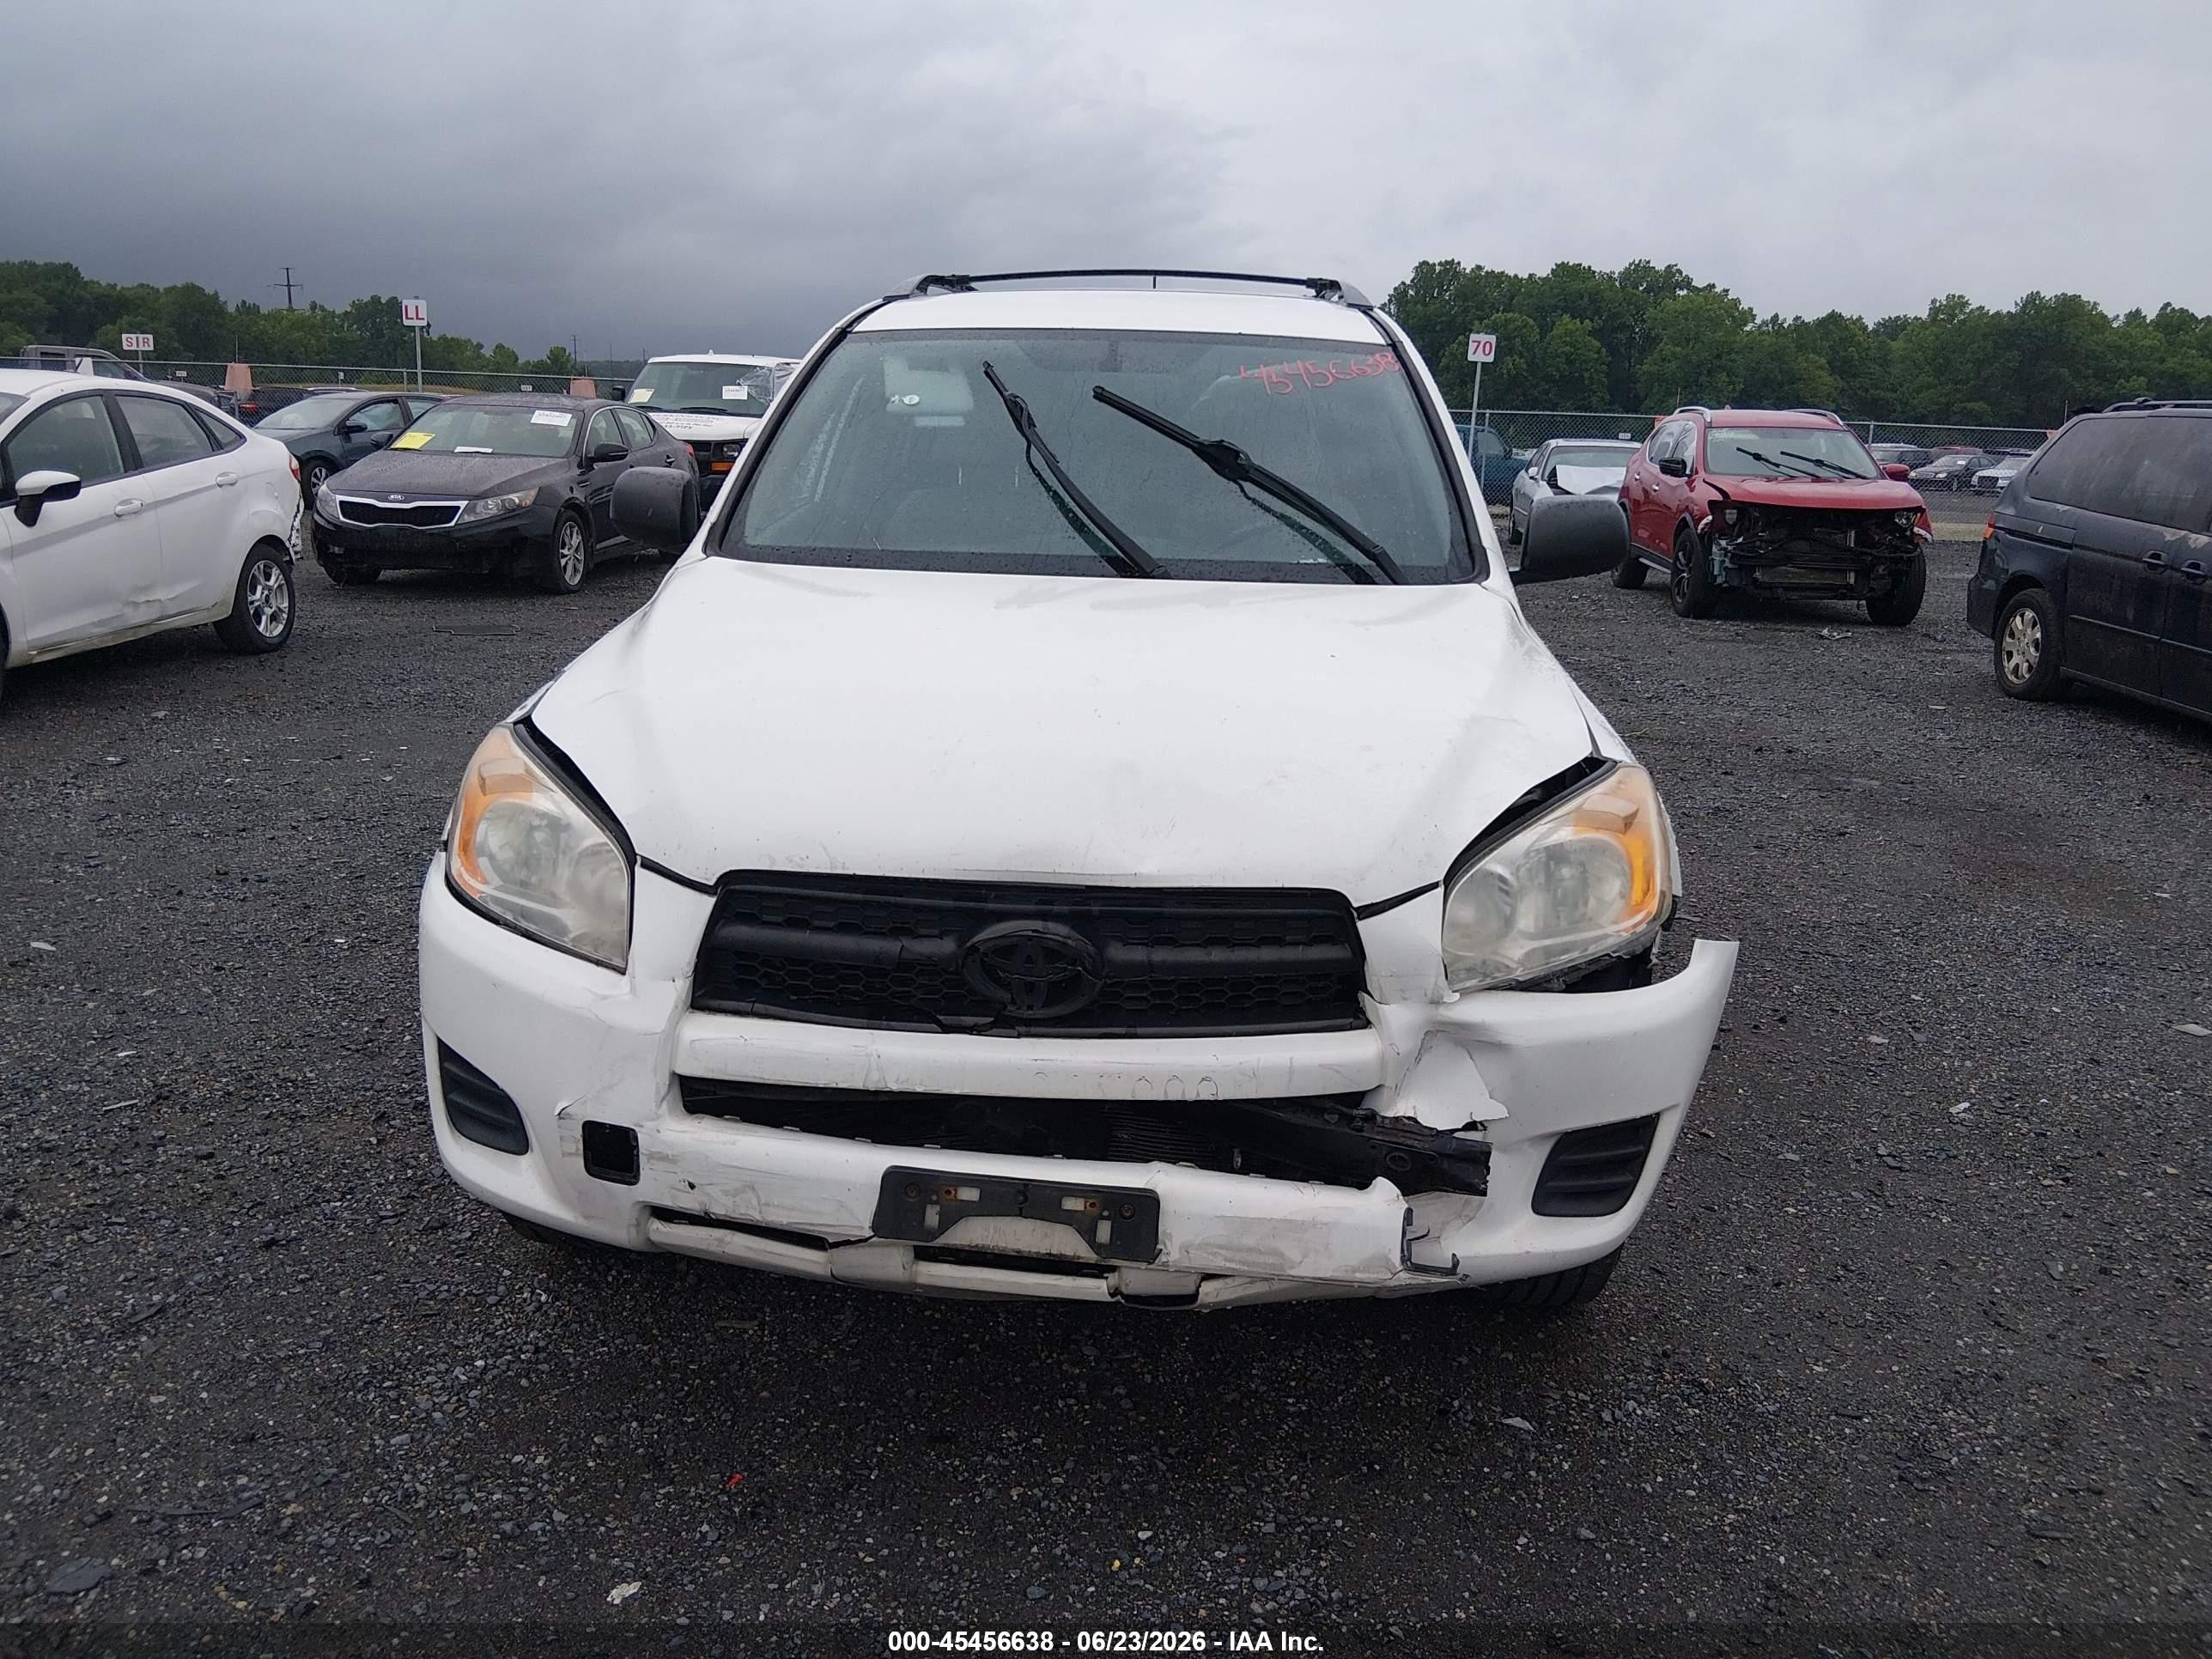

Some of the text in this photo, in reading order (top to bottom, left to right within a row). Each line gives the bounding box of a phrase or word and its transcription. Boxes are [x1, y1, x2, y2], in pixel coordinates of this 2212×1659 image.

[404, 305, 425, 320] LL
[1471, 340, 1492, 356] 70
[1239, 352, 1400, 396] 45456638
